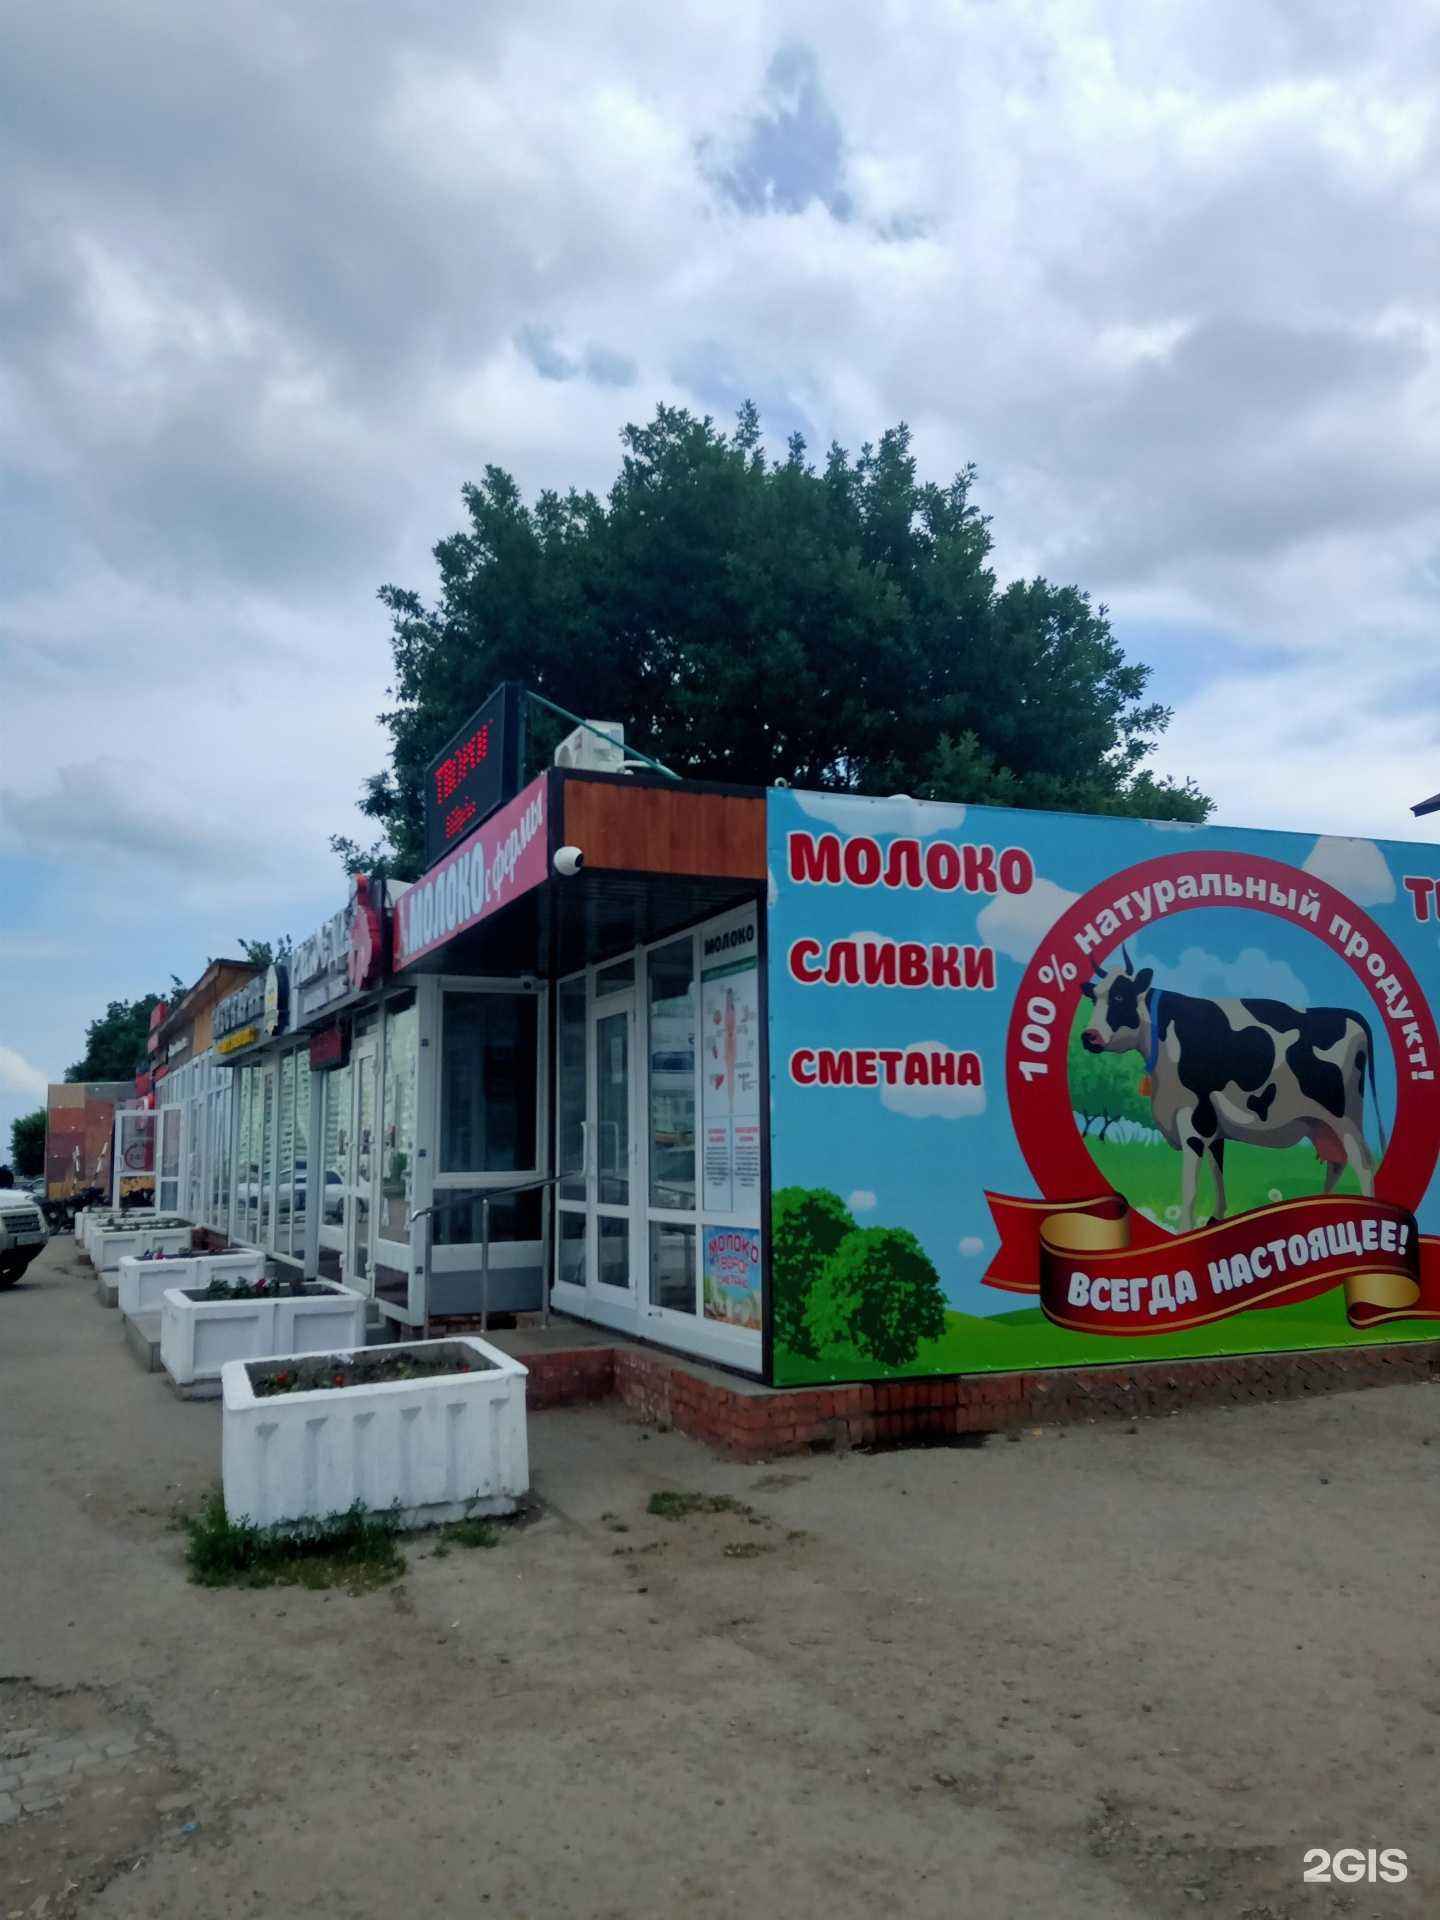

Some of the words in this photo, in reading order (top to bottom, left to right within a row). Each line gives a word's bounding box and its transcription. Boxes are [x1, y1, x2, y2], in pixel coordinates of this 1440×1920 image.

[788, 831, 1034, 894] МОЛОКО
[409, 842, 485, 954] МОЛОКО
[1073, 872, 1322, 956] натуральный
[1403, 875, 1440, 922] Т
[704, 924, 755, 956] МОЛОКО
[789, 938, 996, 991] СЛИВКИ
[1037, 953, 1078, 992] %
[1328, 913, 1436, 1081] продукт!
[791, 1047, 983, 1087] СМЕТАНА
[1019, 996, 1056, 1083] 100
[708, 1233, 759, 1264] МОЛОКО
[1068, 1269, 1198, 1316] ВСЕГДА
[1208, 1217, 1410, 1295] НАСТОЯЩЕЕ!
